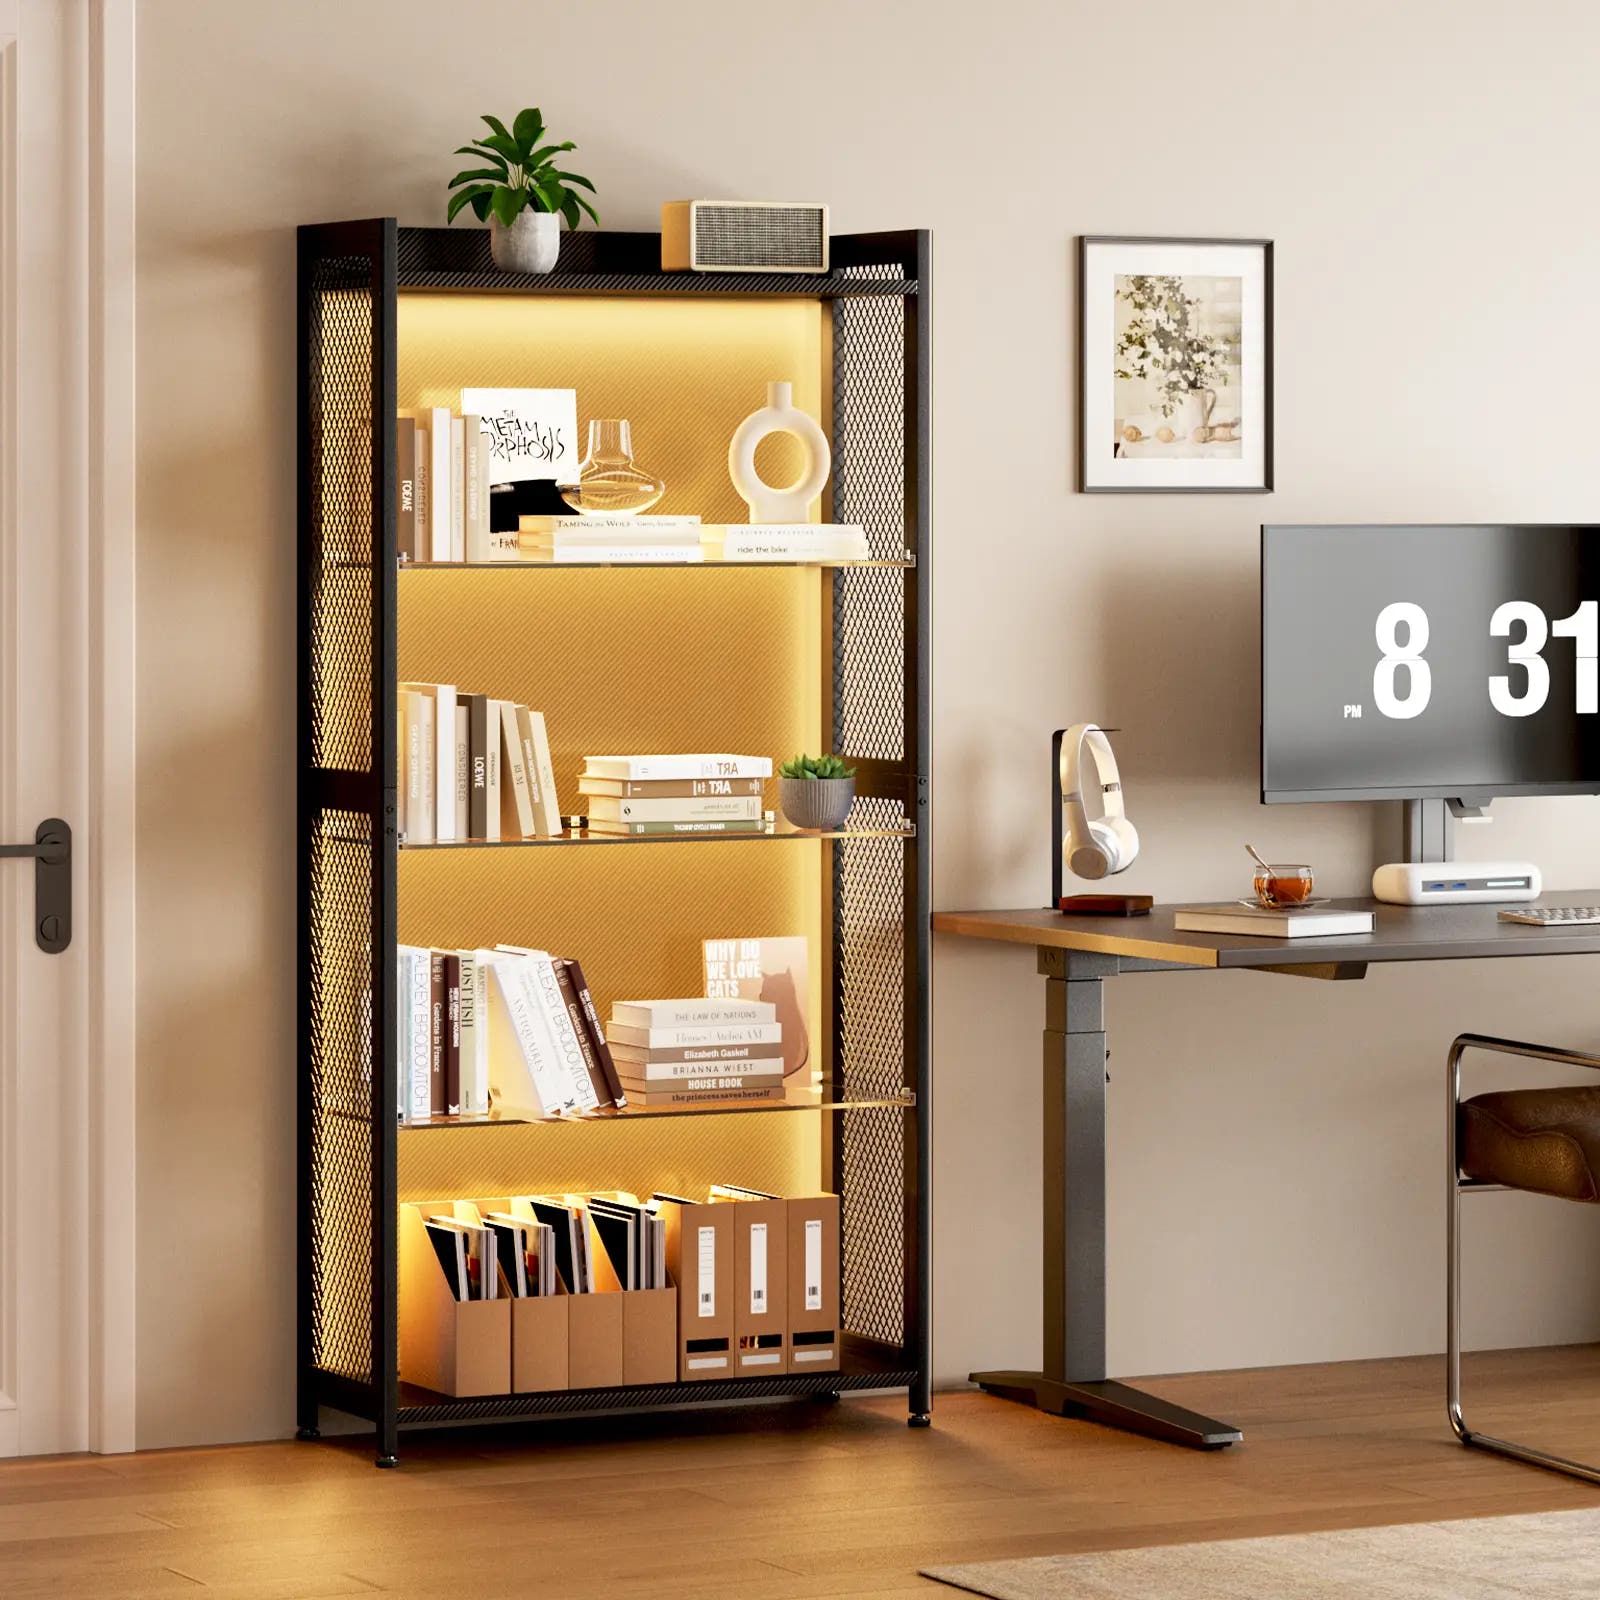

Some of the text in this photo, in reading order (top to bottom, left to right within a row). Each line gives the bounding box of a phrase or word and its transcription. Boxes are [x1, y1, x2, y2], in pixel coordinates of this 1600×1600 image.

[1344, 601, 1598, 719] PM 8 31
[458, 744, 466, 802] CONSIDERED
[474, 756, 485, 789] LOEWE
[705, 940, 760, 961] WHY DO
[706, 960, 761, 979] WE LOVE
[461, 958, 473, 1028] LOST FISH
[537, 960, 561, 1014] ALEXEY
[707, 980, 739, 997] CATS
[414, 953, 428, 1107] ALEXEY BRODOVITCH
[675, 1013, 689, 1021] THE
[693, 1012, 708, 1020] LAW
[710, 1012, 720, 1020] OF
[433, 1002, 442, 1073] Gardens in France
[567, 1002, 584, 1034] Gardens
[580, 1042, 595, 1068] France
[672, 1063, 754, 1074] BRIANNA WIEST
[684, 1049, 719, 1059] Elizabeth
[688, 1077, 743, 1090] HOUSE BOOK
